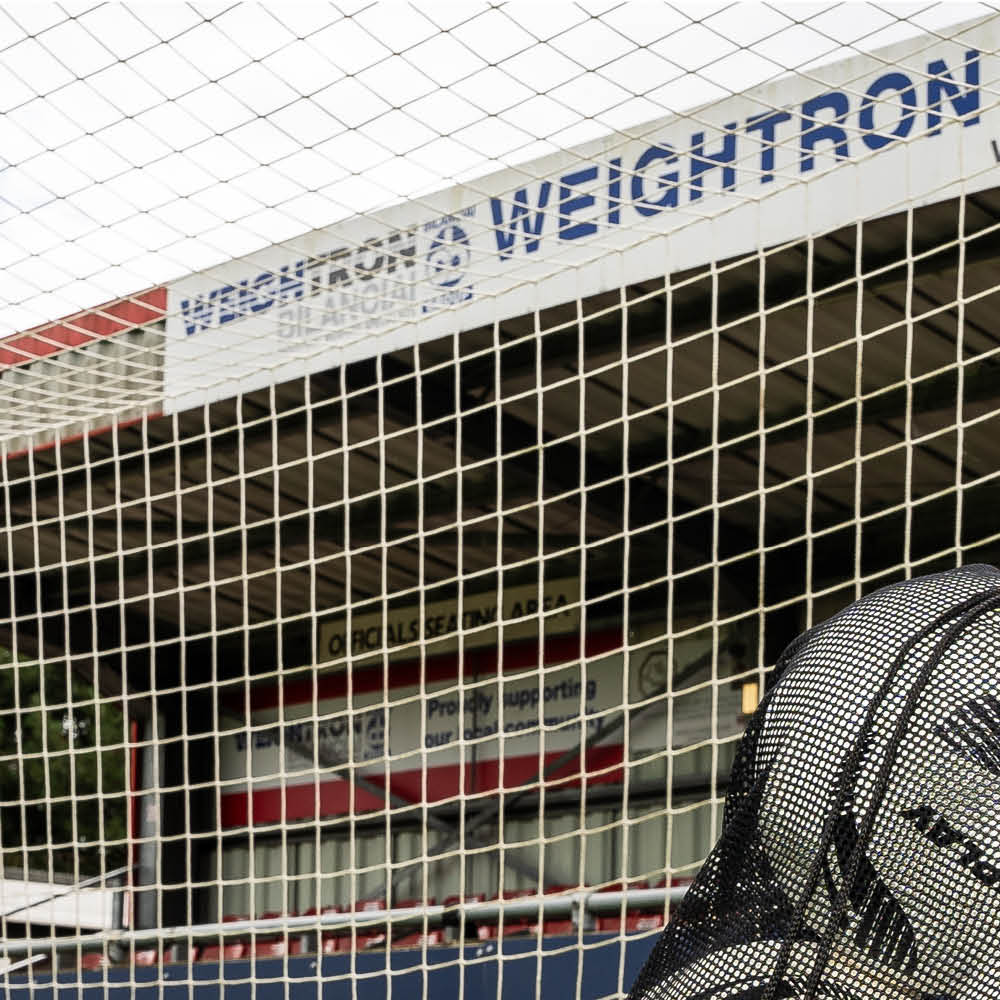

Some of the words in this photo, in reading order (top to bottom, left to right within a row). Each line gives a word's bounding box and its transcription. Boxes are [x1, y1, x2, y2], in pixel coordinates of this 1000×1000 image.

[490, 50, 980, 261] WEIGHTRON
[181, 226, 416, 336] WEIGHTRON
[425, 607, 498, 639] SEATIN
[503, 679, 597, 710] supporting
[460, 722, 499, 742] ocal
